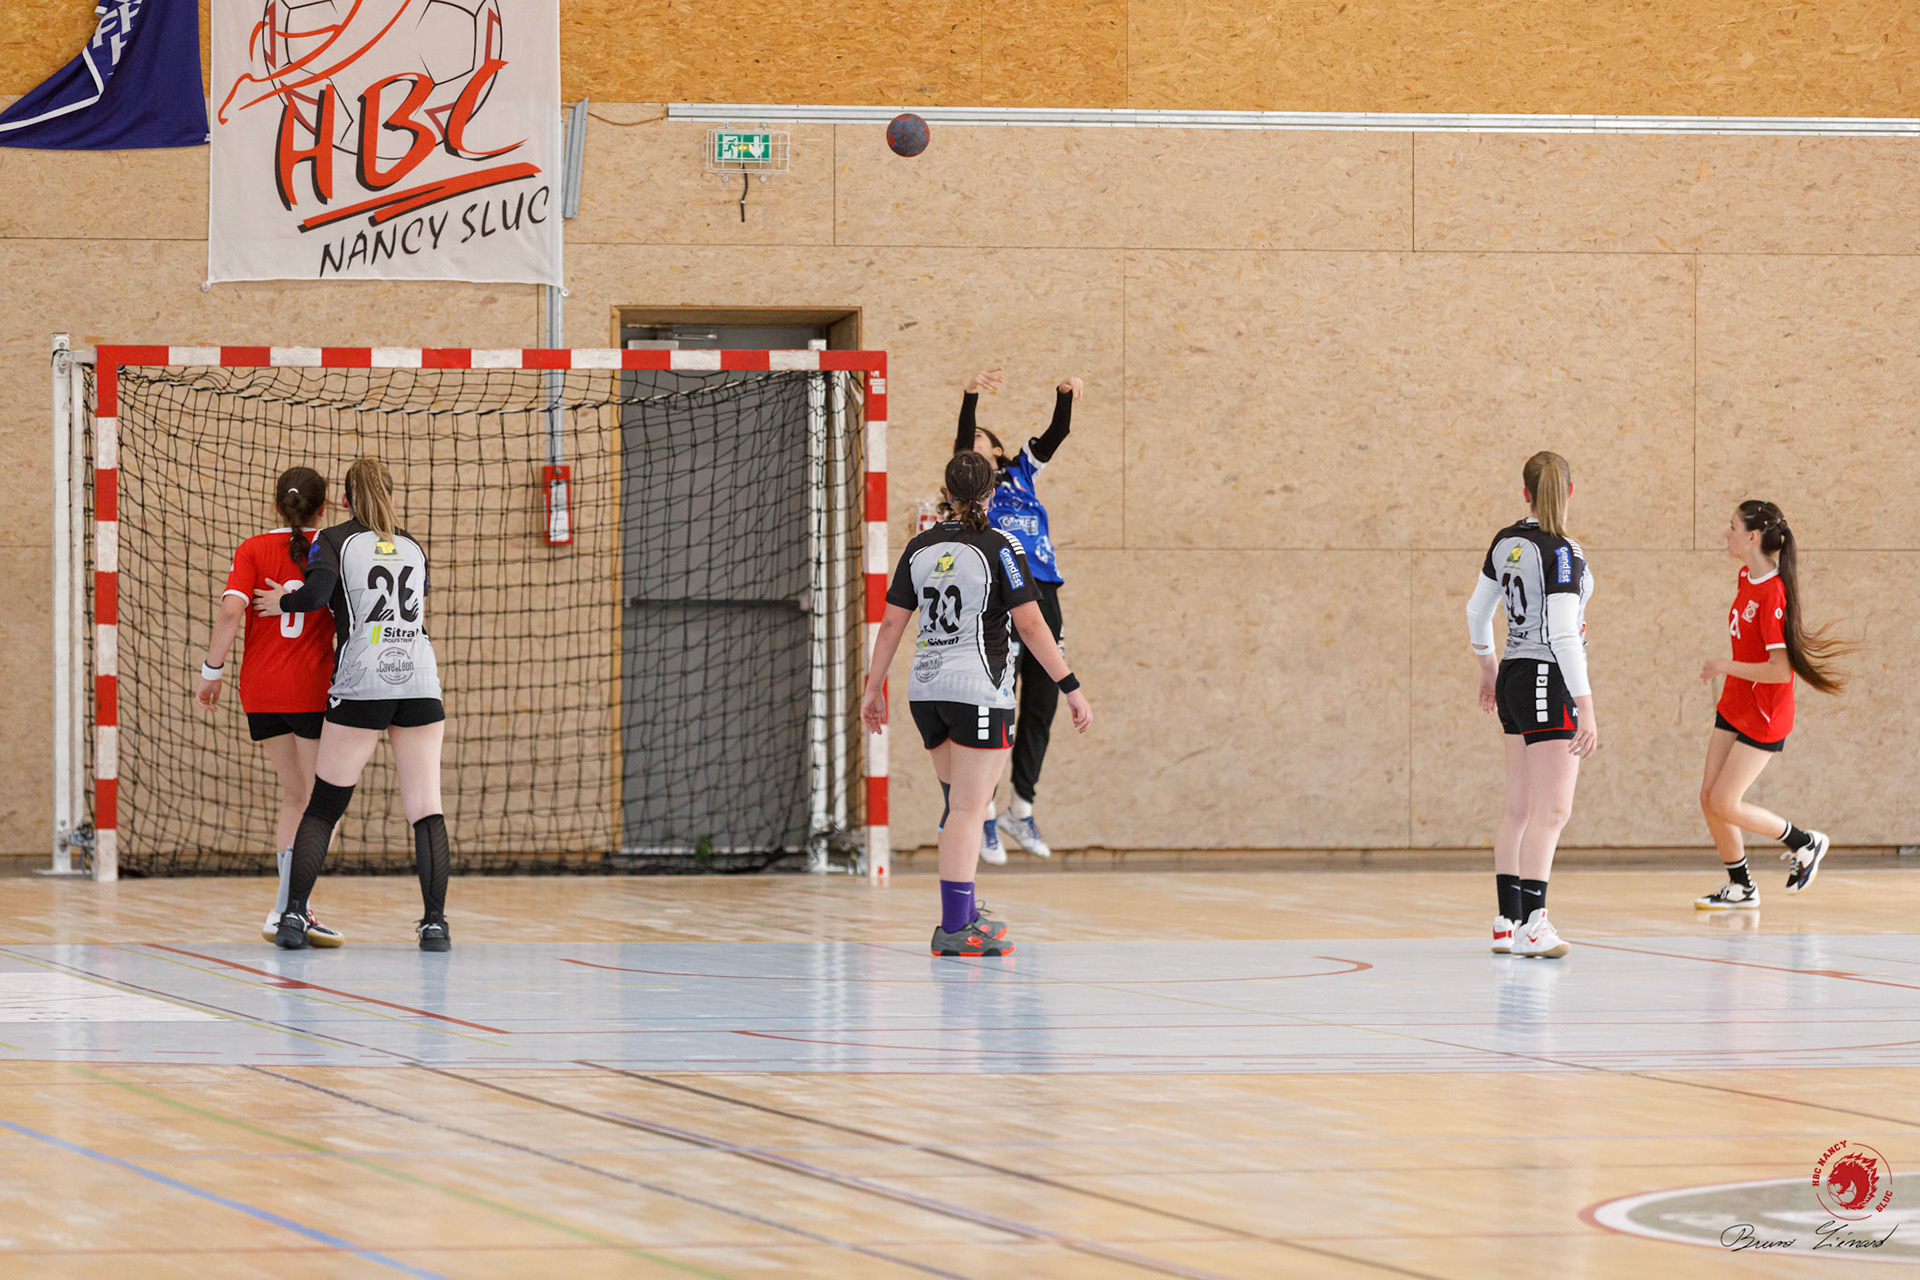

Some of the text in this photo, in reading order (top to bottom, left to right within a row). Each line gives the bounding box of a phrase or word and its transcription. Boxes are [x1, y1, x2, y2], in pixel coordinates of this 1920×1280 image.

[275, 60, 530, 211] HBC
[319, 186, 550, 278] NANCY SLUC
[364, 565, 419, 623] 26
